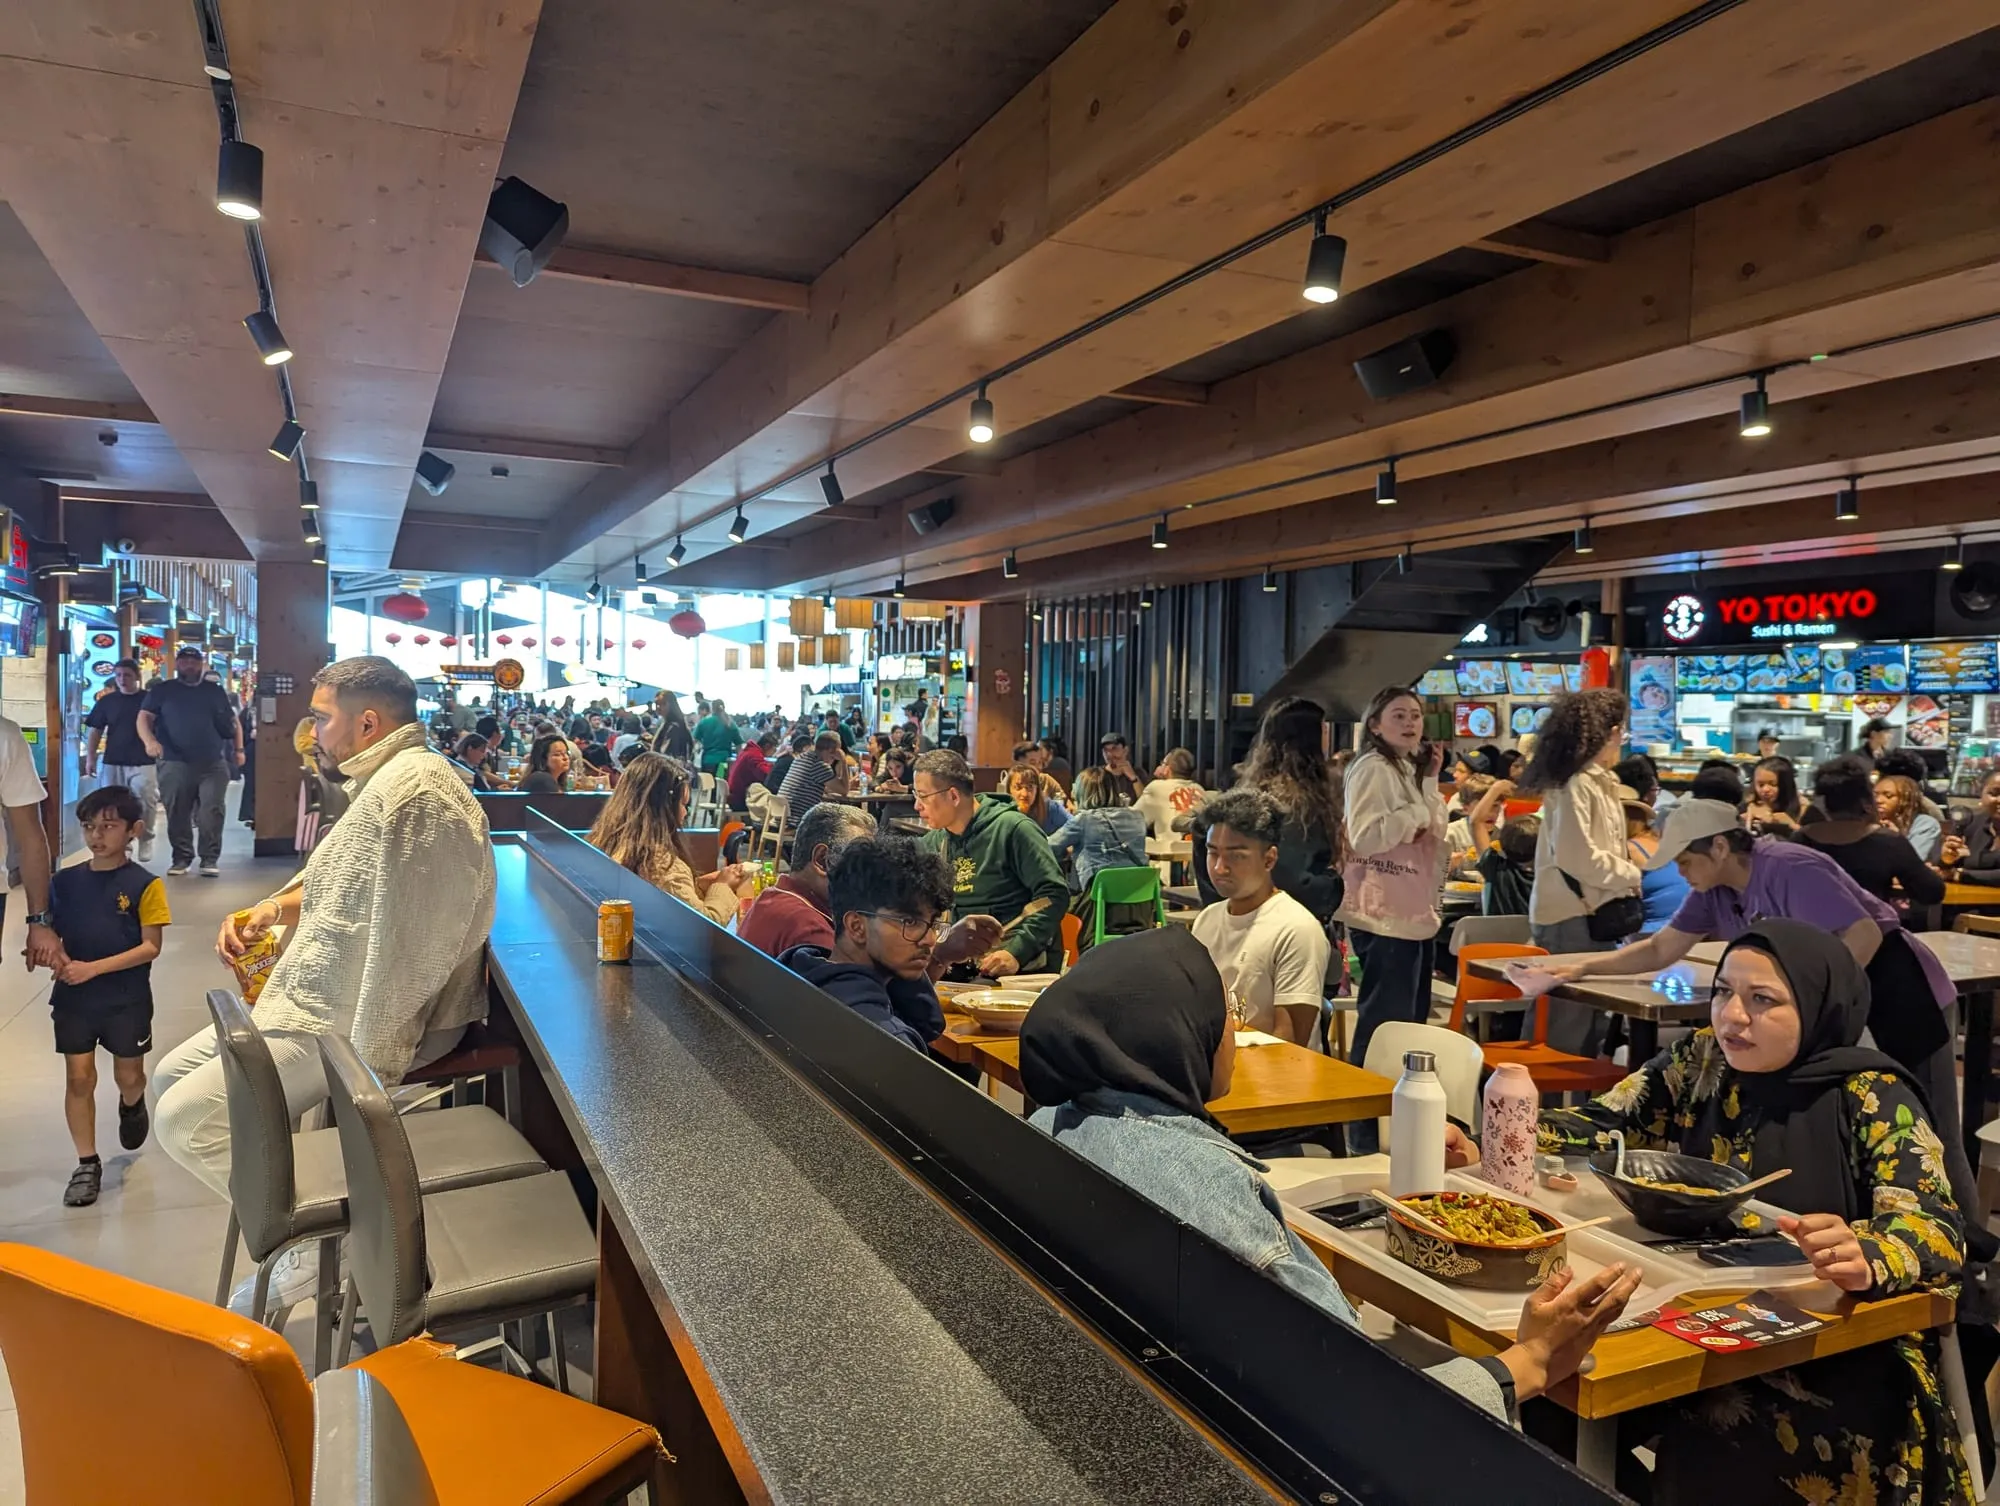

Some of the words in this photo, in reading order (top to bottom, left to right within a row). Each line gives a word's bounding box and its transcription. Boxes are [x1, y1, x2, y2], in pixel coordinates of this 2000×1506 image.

[1718, 597, 1760, 623] YO
[1763, 588, 1877, 621] TOKYO
[1751, 624, 1781, 637] Sushi
[1782, 624, 1793, 636] &
[1795, 623, 1836, 636] Ramen
[1346, 855, 1384, 867] London
[1696, 1310, 1730, 1322] 15%
